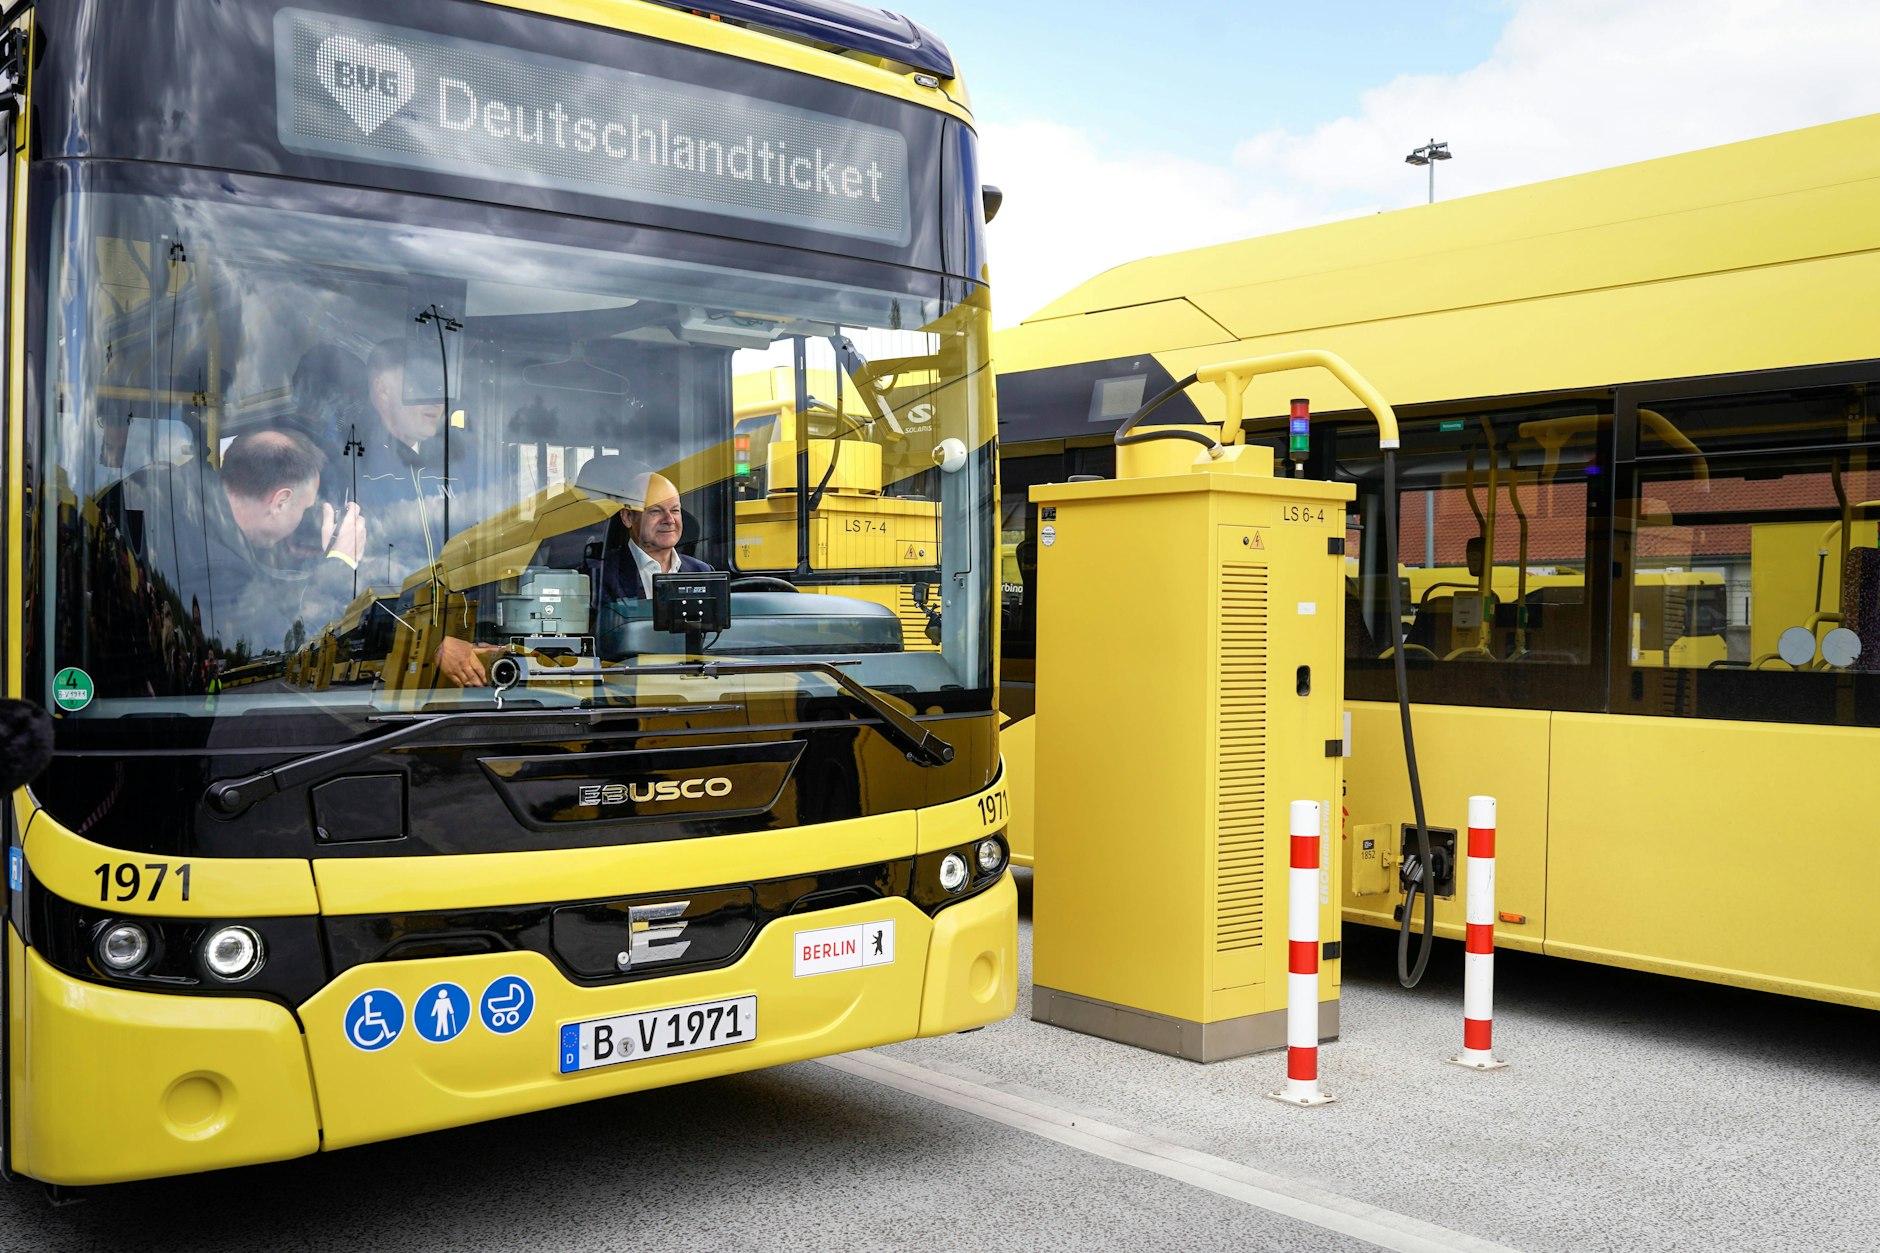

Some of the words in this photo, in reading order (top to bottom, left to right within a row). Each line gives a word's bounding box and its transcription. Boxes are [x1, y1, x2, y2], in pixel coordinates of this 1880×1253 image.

[438, 76, 883, 203] Deutschlandticket
[905, 425, 932, 434] SOLARIS
[1283, 506, 1299, 521] LS
[845, 519, 861, 532] LS
[1001, 583, 1023, 593] rbino
[66, 670, 78, 689] 4
[578, 777, 733, 806] EBUSCO
[978, 789, 1008, 825] 1971
[1361, 850, 1375, 860] 1852
[94, 863, 190, 902] 1971
[803, 939, 856, 961] BERLIN
[566, 1053, 574, 1065] D
